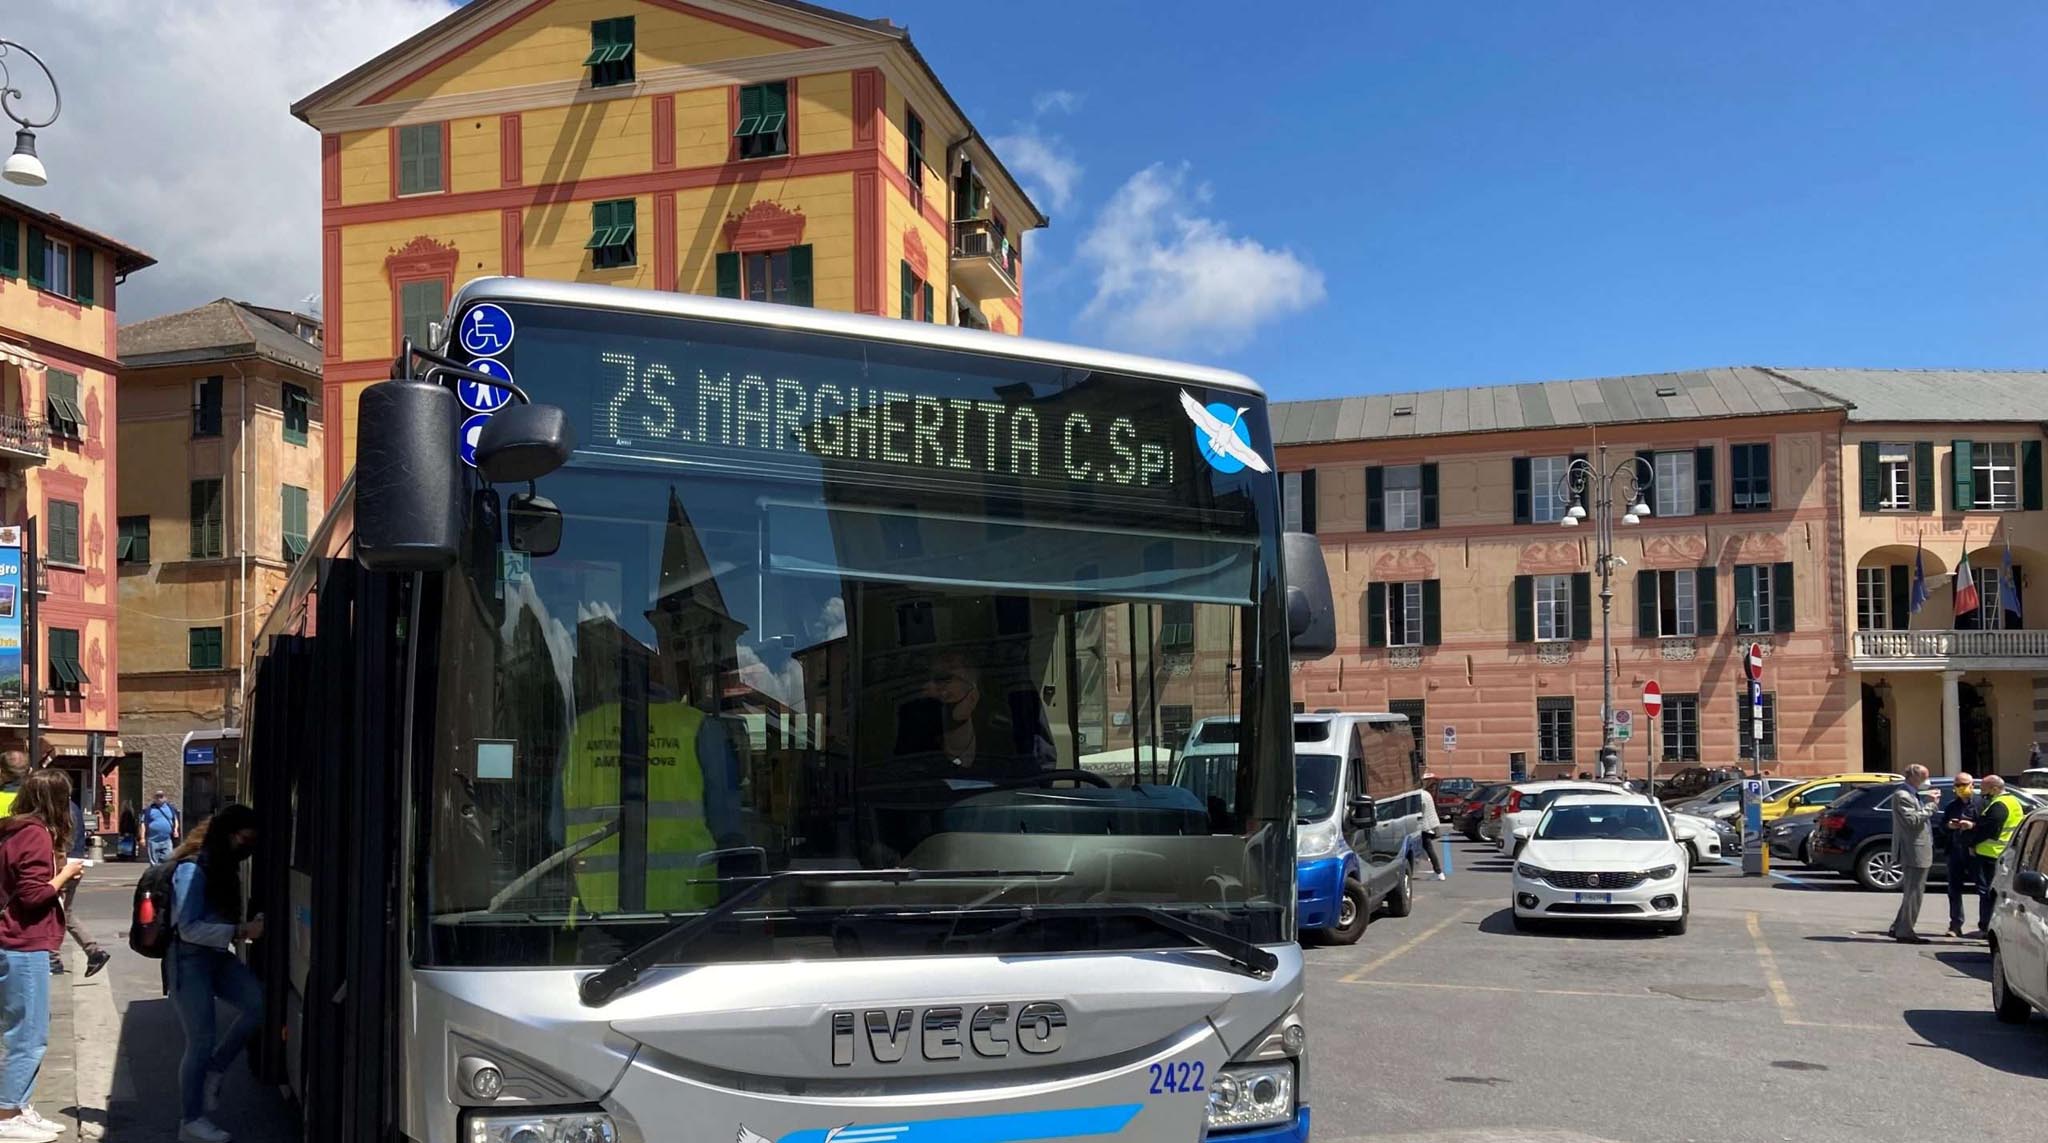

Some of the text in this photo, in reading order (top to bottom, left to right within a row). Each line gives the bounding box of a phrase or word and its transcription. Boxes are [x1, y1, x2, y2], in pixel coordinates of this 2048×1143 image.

[602, 352, 635, 438] 7
[643, 362, 1039, 476] S.MARGHERITA
[1755, 684, 1761, 703] P
[1752, 783, 1759, 792] P
[832, 1001, 1067, 1066] IVECO
[1149, 1061, 1204, 1094] 2422
